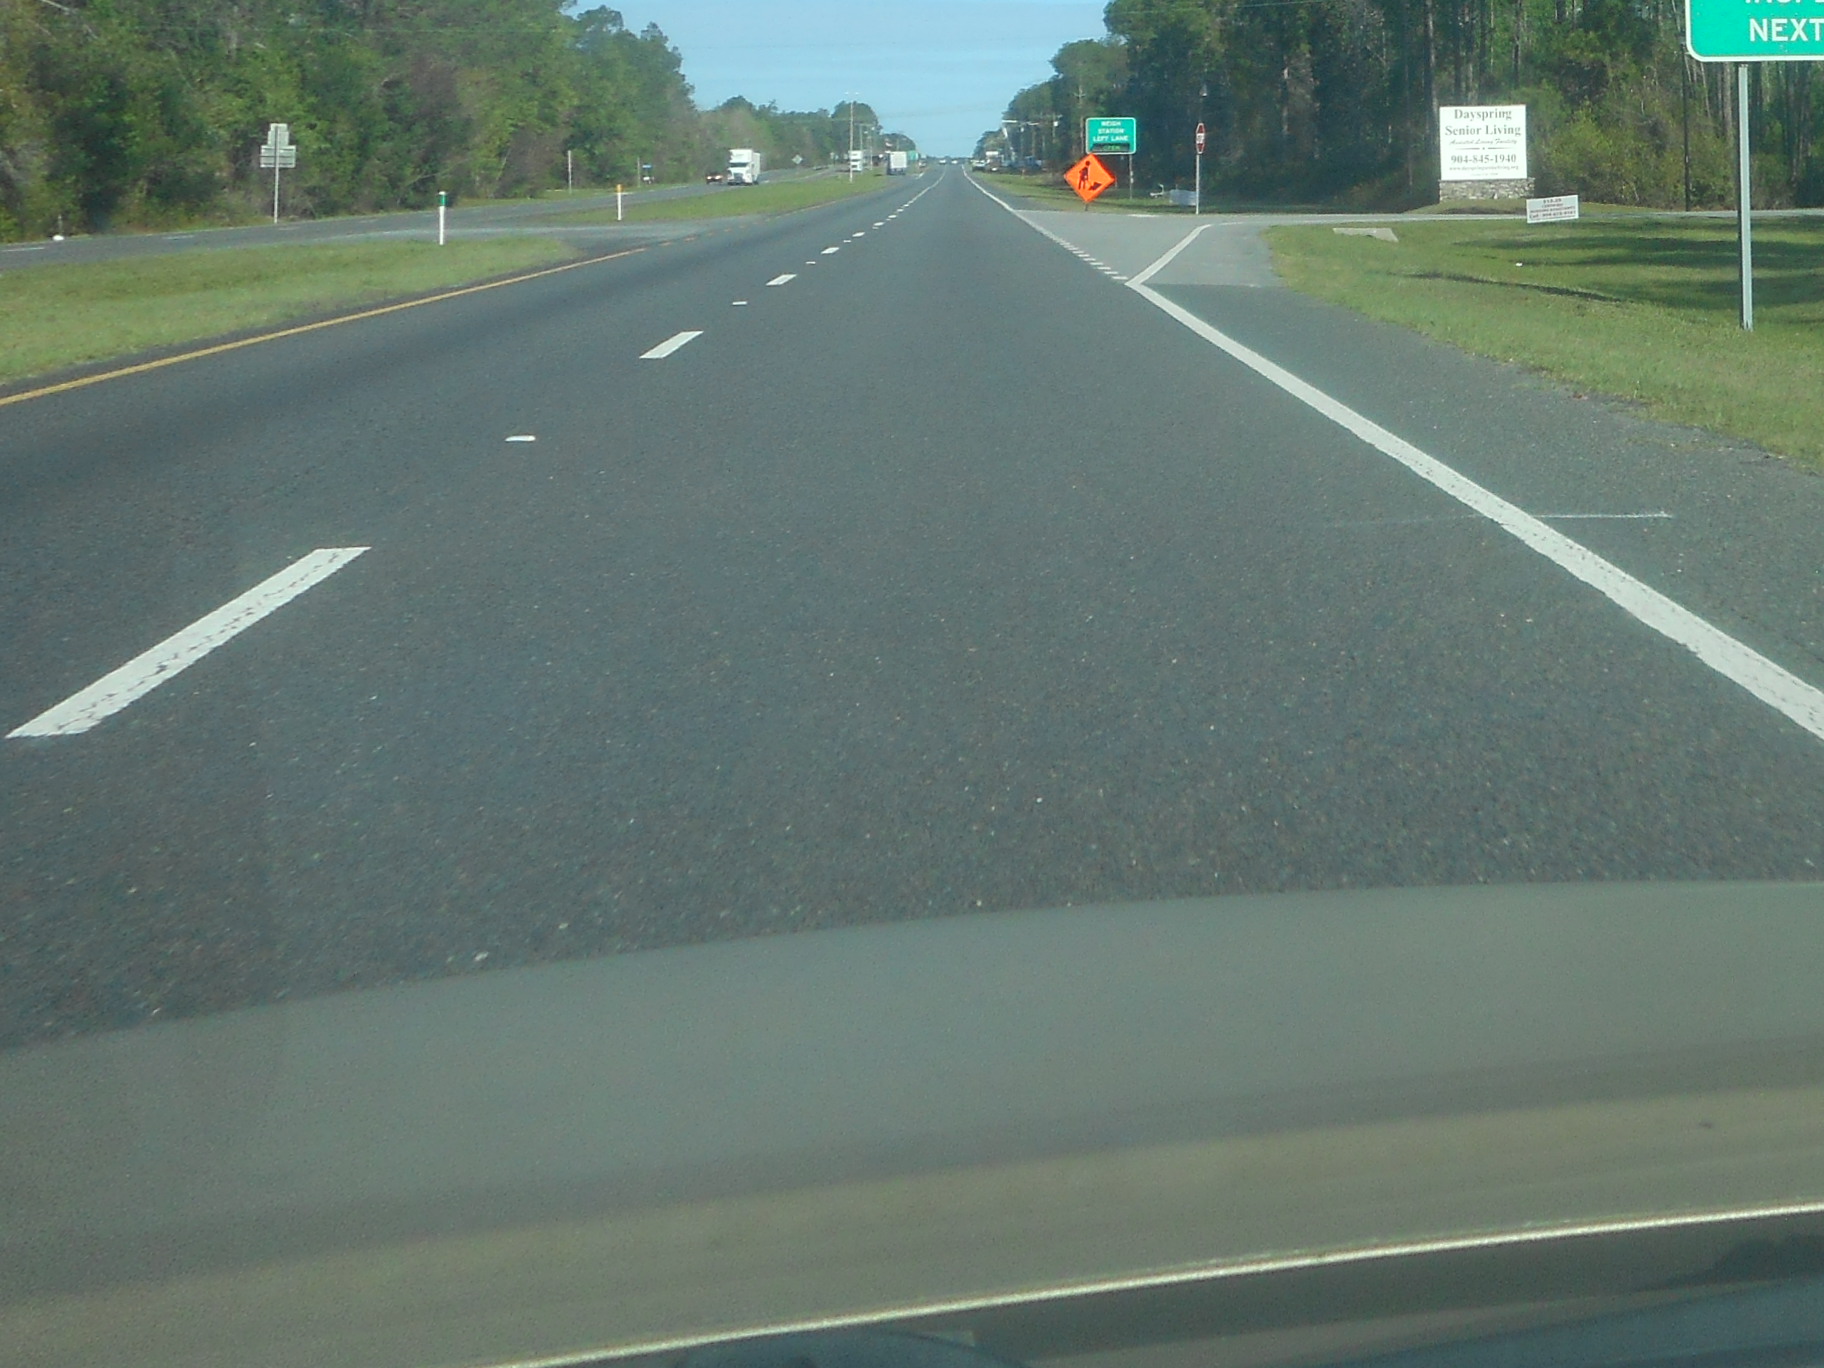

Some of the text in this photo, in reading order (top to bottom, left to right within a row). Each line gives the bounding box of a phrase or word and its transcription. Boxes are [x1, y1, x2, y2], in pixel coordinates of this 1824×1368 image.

[1454, 108, 1512, 122] Dayspring
[1445, 124, 1522, 136] Senior Living
[1450, 154, 1517, 164] 904-845-1940
